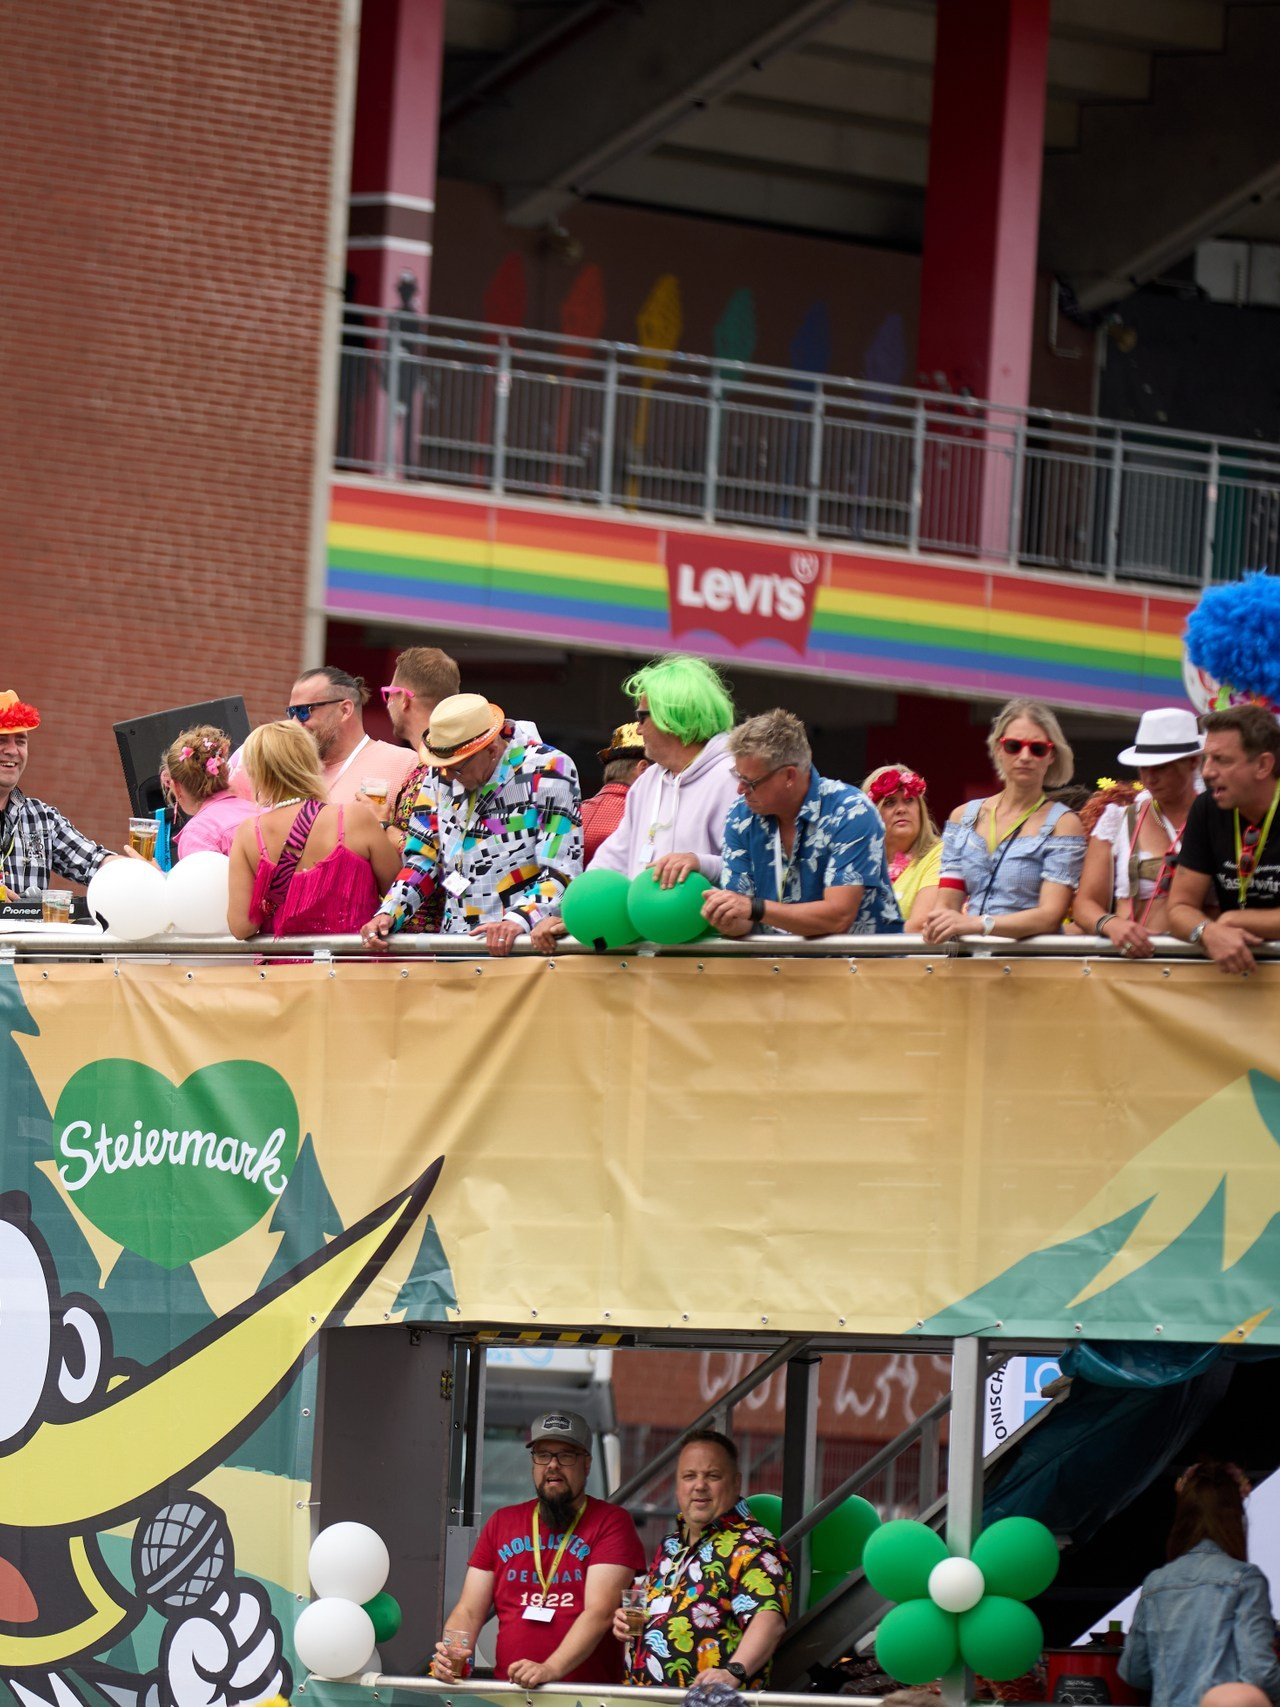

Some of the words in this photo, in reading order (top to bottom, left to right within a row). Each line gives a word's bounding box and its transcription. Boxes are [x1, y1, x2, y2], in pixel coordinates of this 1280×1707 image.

[2, 906, 41, 915] Pioneer
[58, 1119, 288, 1195] Steiermark
[497, 1533, 591, 1564] HOLLISTER
[520, 1591, 574, 1608] 1922
